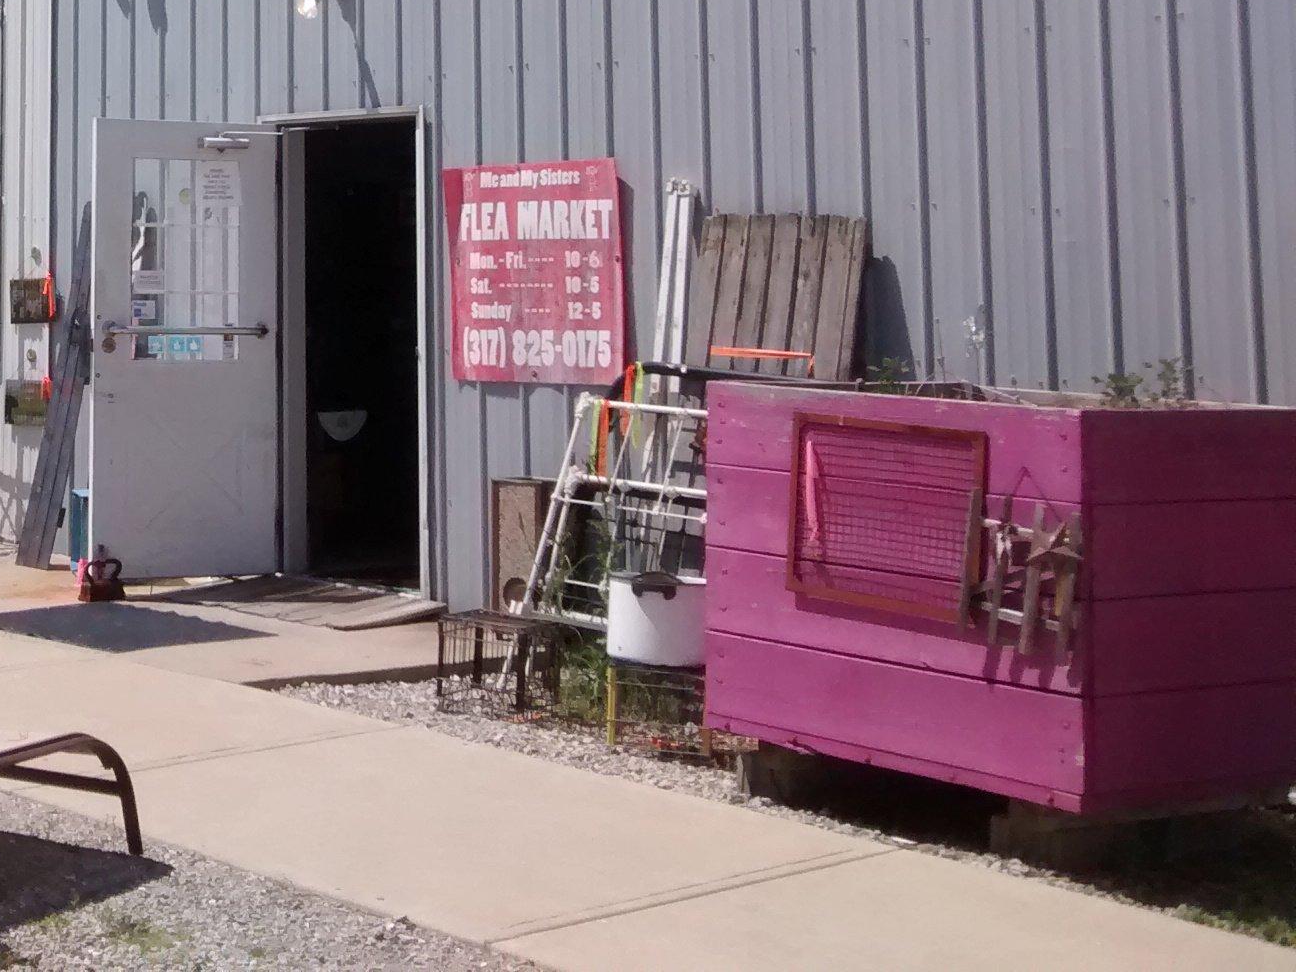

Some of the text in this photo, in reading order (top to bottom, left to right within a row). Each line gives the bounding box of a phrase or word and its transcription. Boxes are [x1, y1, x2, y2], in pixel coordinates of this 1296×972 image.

[479, 168, 581, 189] Me and My Sisters
[461, 199, 613, 241] FLEA MARKET
[470, 277, 492, 294] Sat.
[471, 301, 512, 322] Sunday
[463, 326, 612, 368] (317) 825-0175
